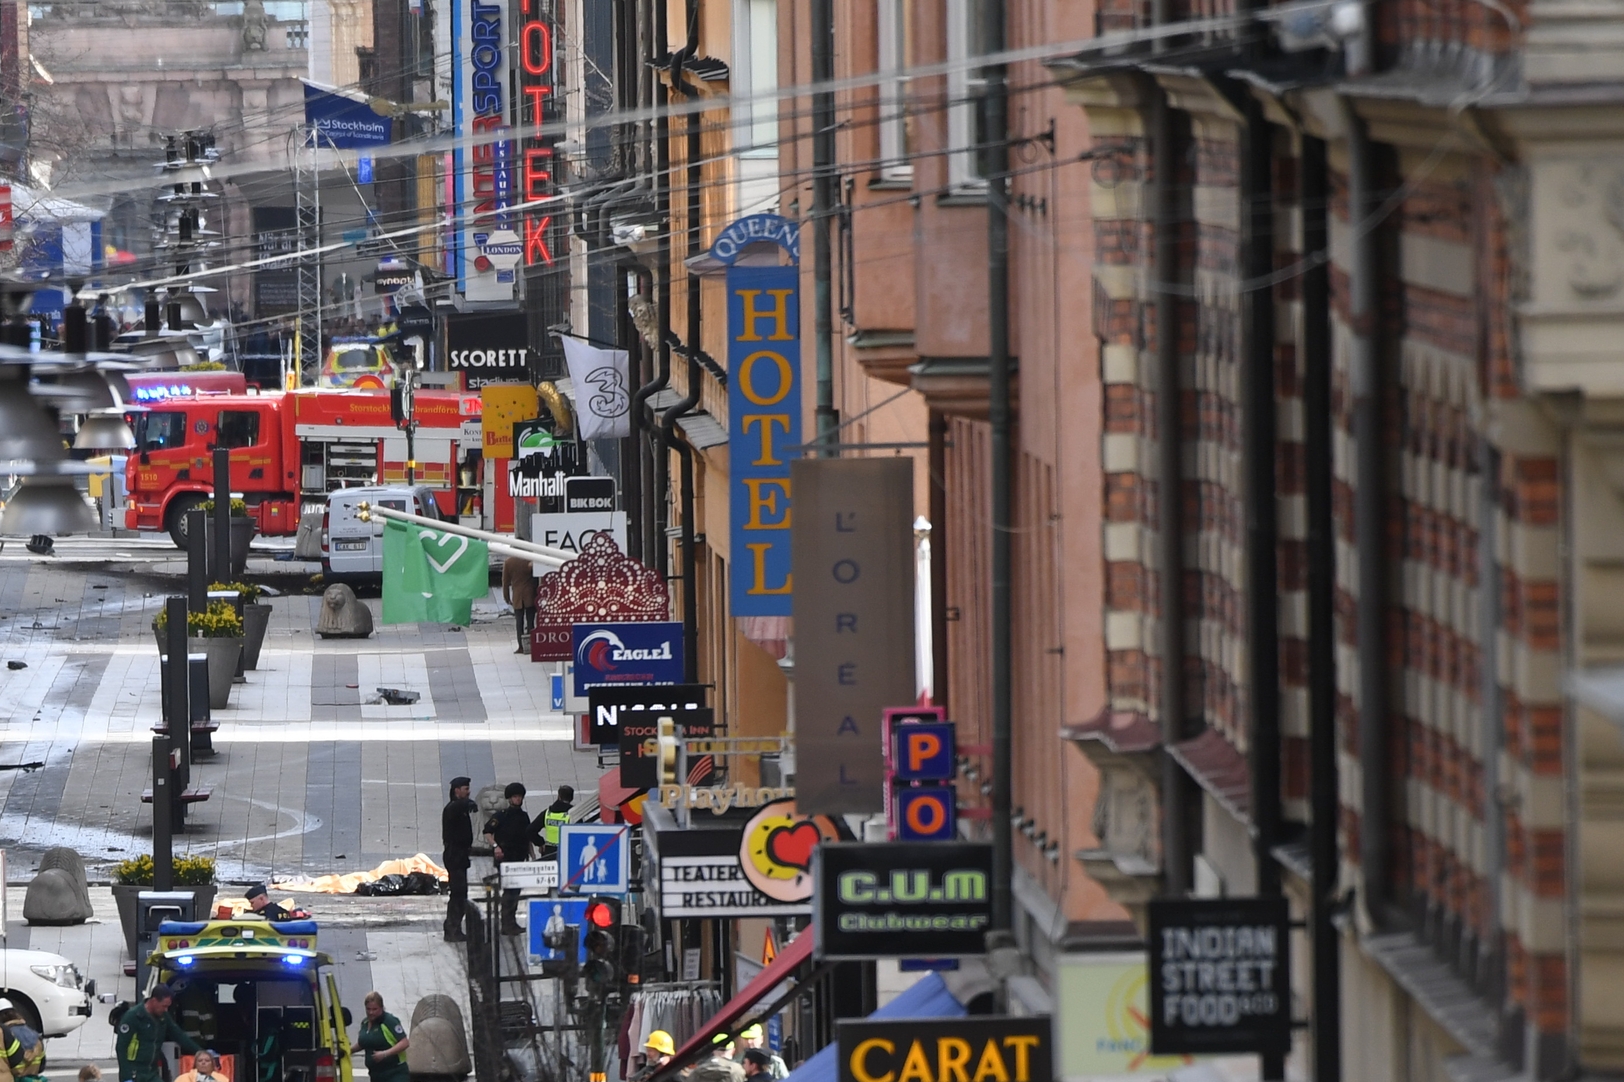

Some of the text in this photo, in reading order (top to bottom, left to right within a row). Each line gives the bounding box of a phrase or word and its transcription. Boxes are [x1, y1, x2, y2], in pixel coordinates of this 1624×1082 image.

[331, 120, 384, 133] Stockholm
[520, 0, 555, 268] OTEK
[451, 350, 527, 367] SCORETT
[734, 289, 794, 595] HOTEL
[140, 473, 158, 482] 1510
[570, 498, 612, 509] BIK BOK
[535, 631, 573, 644] DRO
[838, 912, 989, 932] Clubwear
[1162, 927, 1275, 959] INDIAN
[1162, 961, 1274, 991] STREET
[1164, 994, 1240, 1027] FOOD
